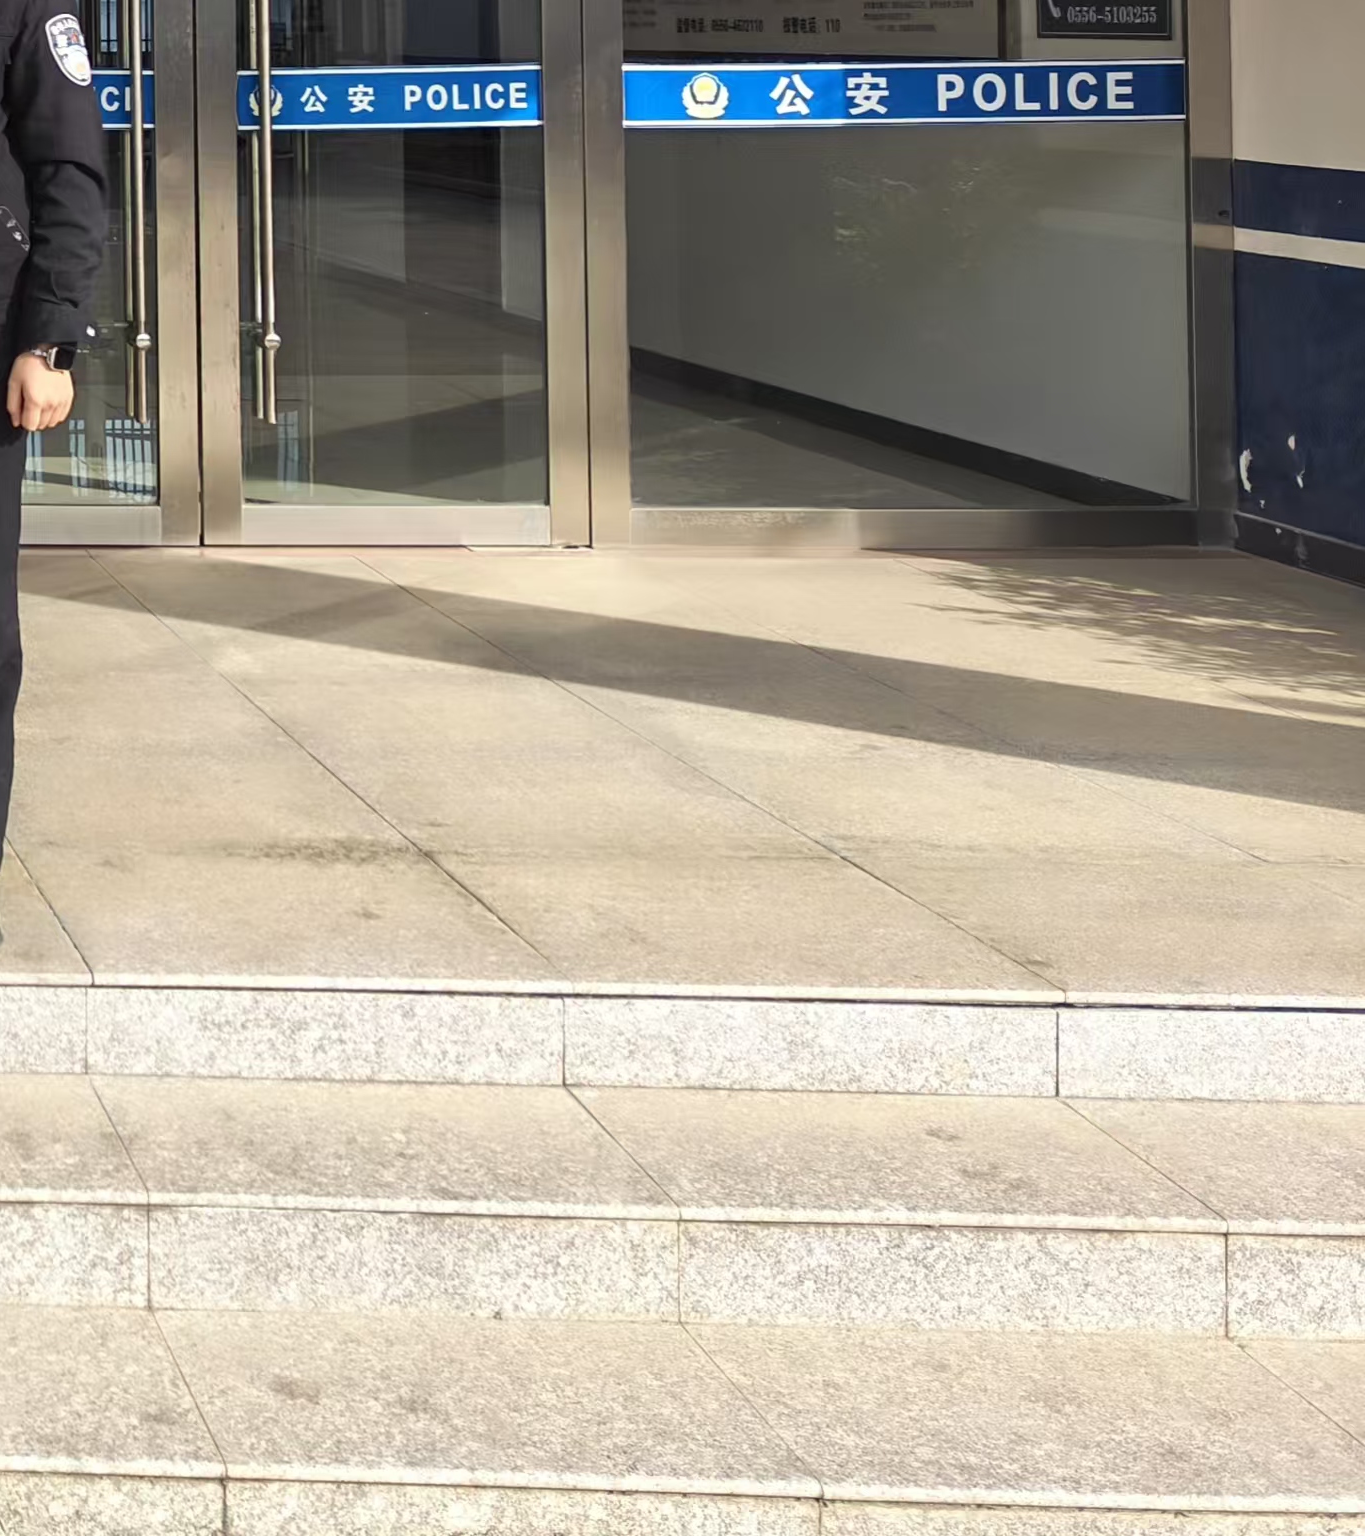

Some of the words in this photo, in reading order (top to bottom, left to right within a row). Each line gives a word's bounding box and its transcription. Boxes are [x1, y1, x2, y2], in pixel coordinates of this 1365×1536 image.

[1067, 5, 1157, 24] 0556-5103255
[299, 84, 376, 114] 公安
[404, 81, 528, 111] POLICE
[769, 73, 890, 116] 公安
[937, 71, 1135, 112] POLICE
